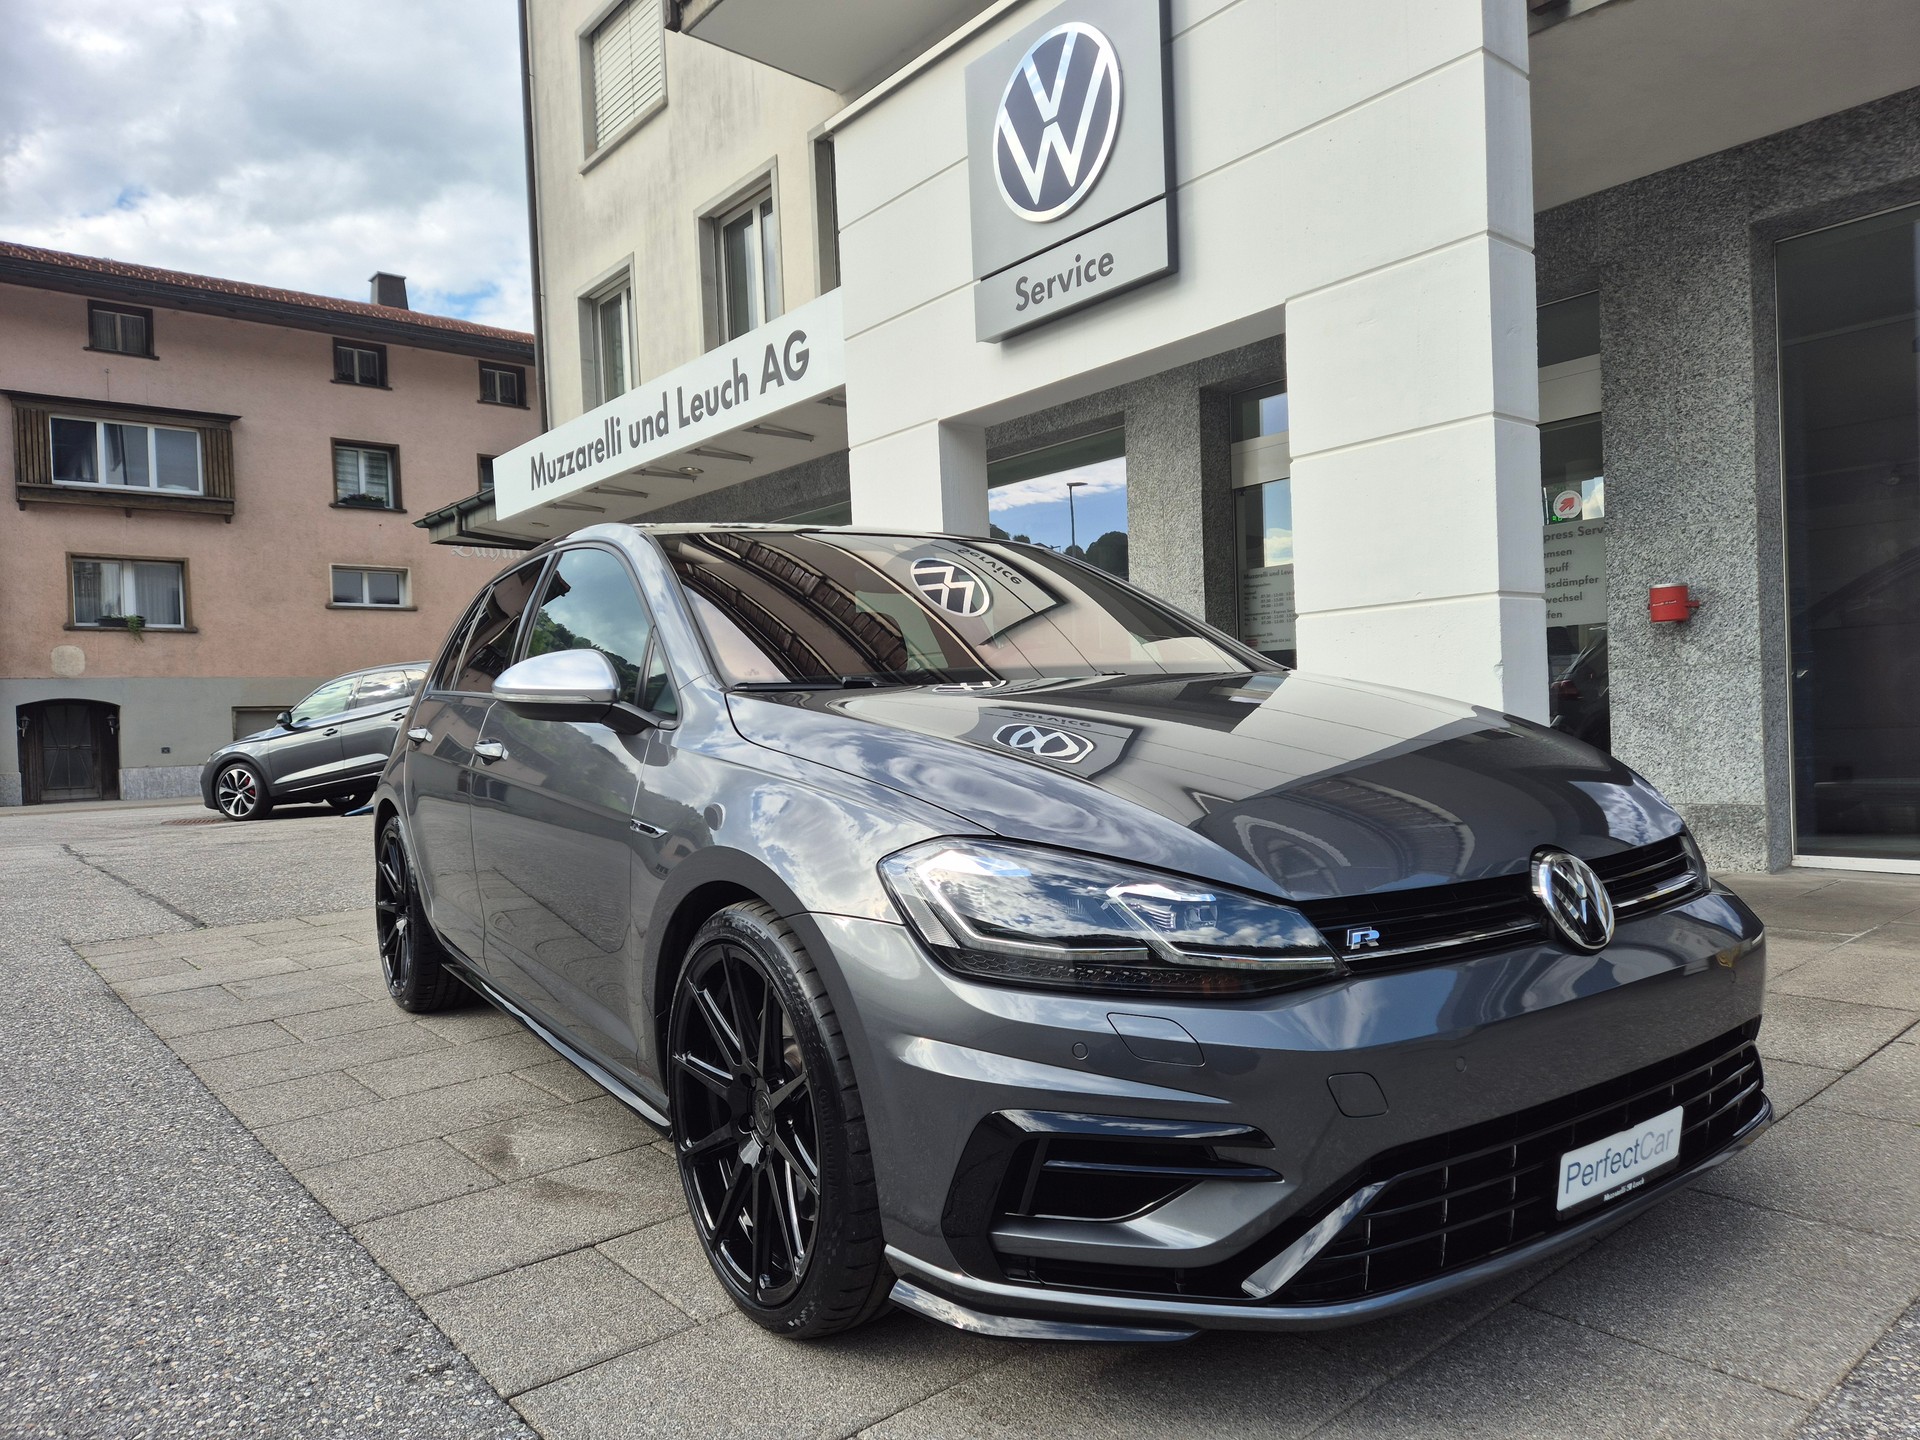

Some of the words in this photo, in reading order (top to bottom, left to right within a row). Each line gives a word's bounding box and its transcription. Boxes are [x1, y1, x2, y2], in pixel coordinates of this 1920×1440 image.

[1015, 252, 1114, 312] Service
[530, 415, 622, 491] Muzzarelli
[628, 391, 669, 449] und
[676, 357, 749, 429] Leuch
[759, 329, 810, 395] AG
[1545, 575, 1599, 588] ssdämpfer
[1346, 926, 1380, 950] R
[1565, 1128, 1674, 1195] PerfectCar
